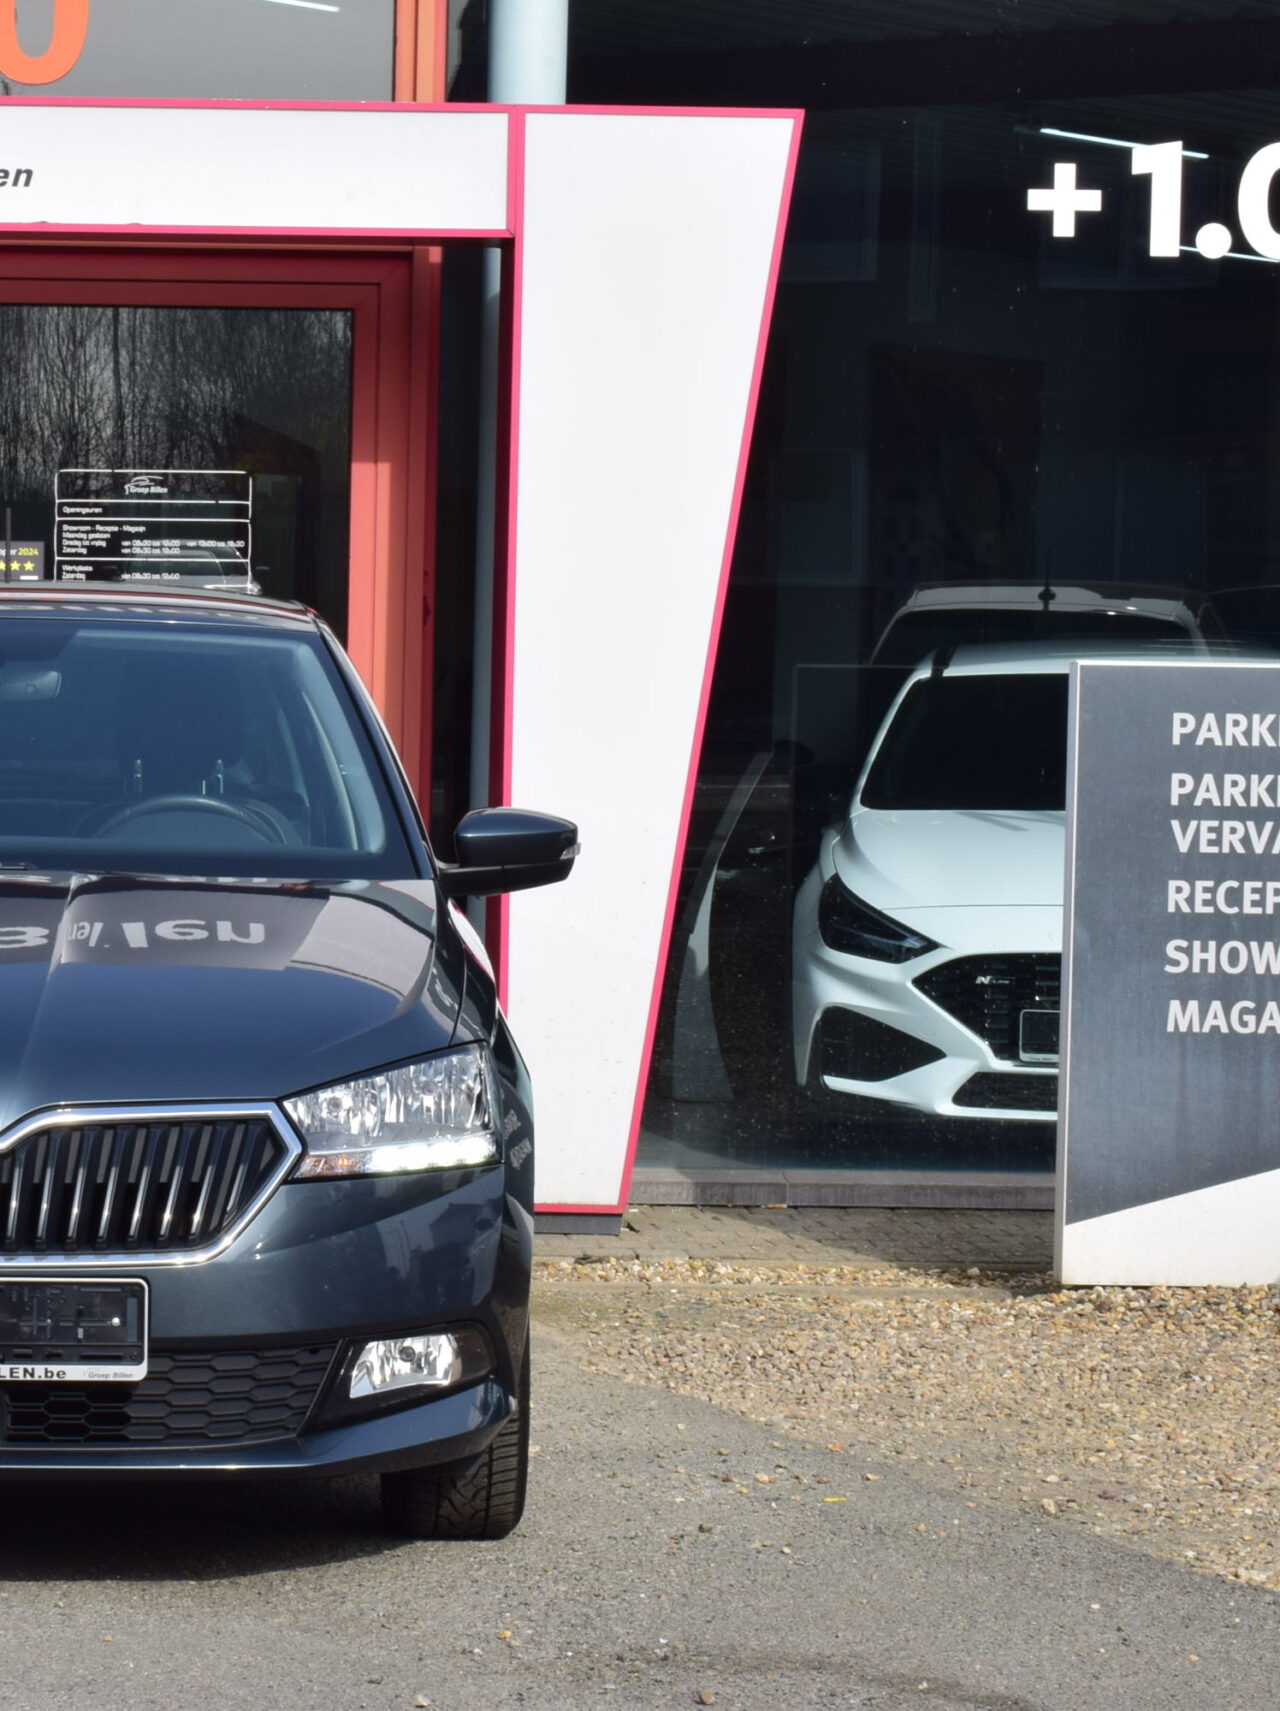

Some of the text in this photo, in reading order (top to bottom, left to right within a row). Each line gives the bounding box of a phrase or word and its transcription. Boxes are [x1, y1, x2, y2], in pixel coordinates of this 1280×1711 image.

[18, 547, 39, 556] 2024
[1166, 999, 1280, 1035] MAGA
[88, 1371, 111, 1379] Groep
